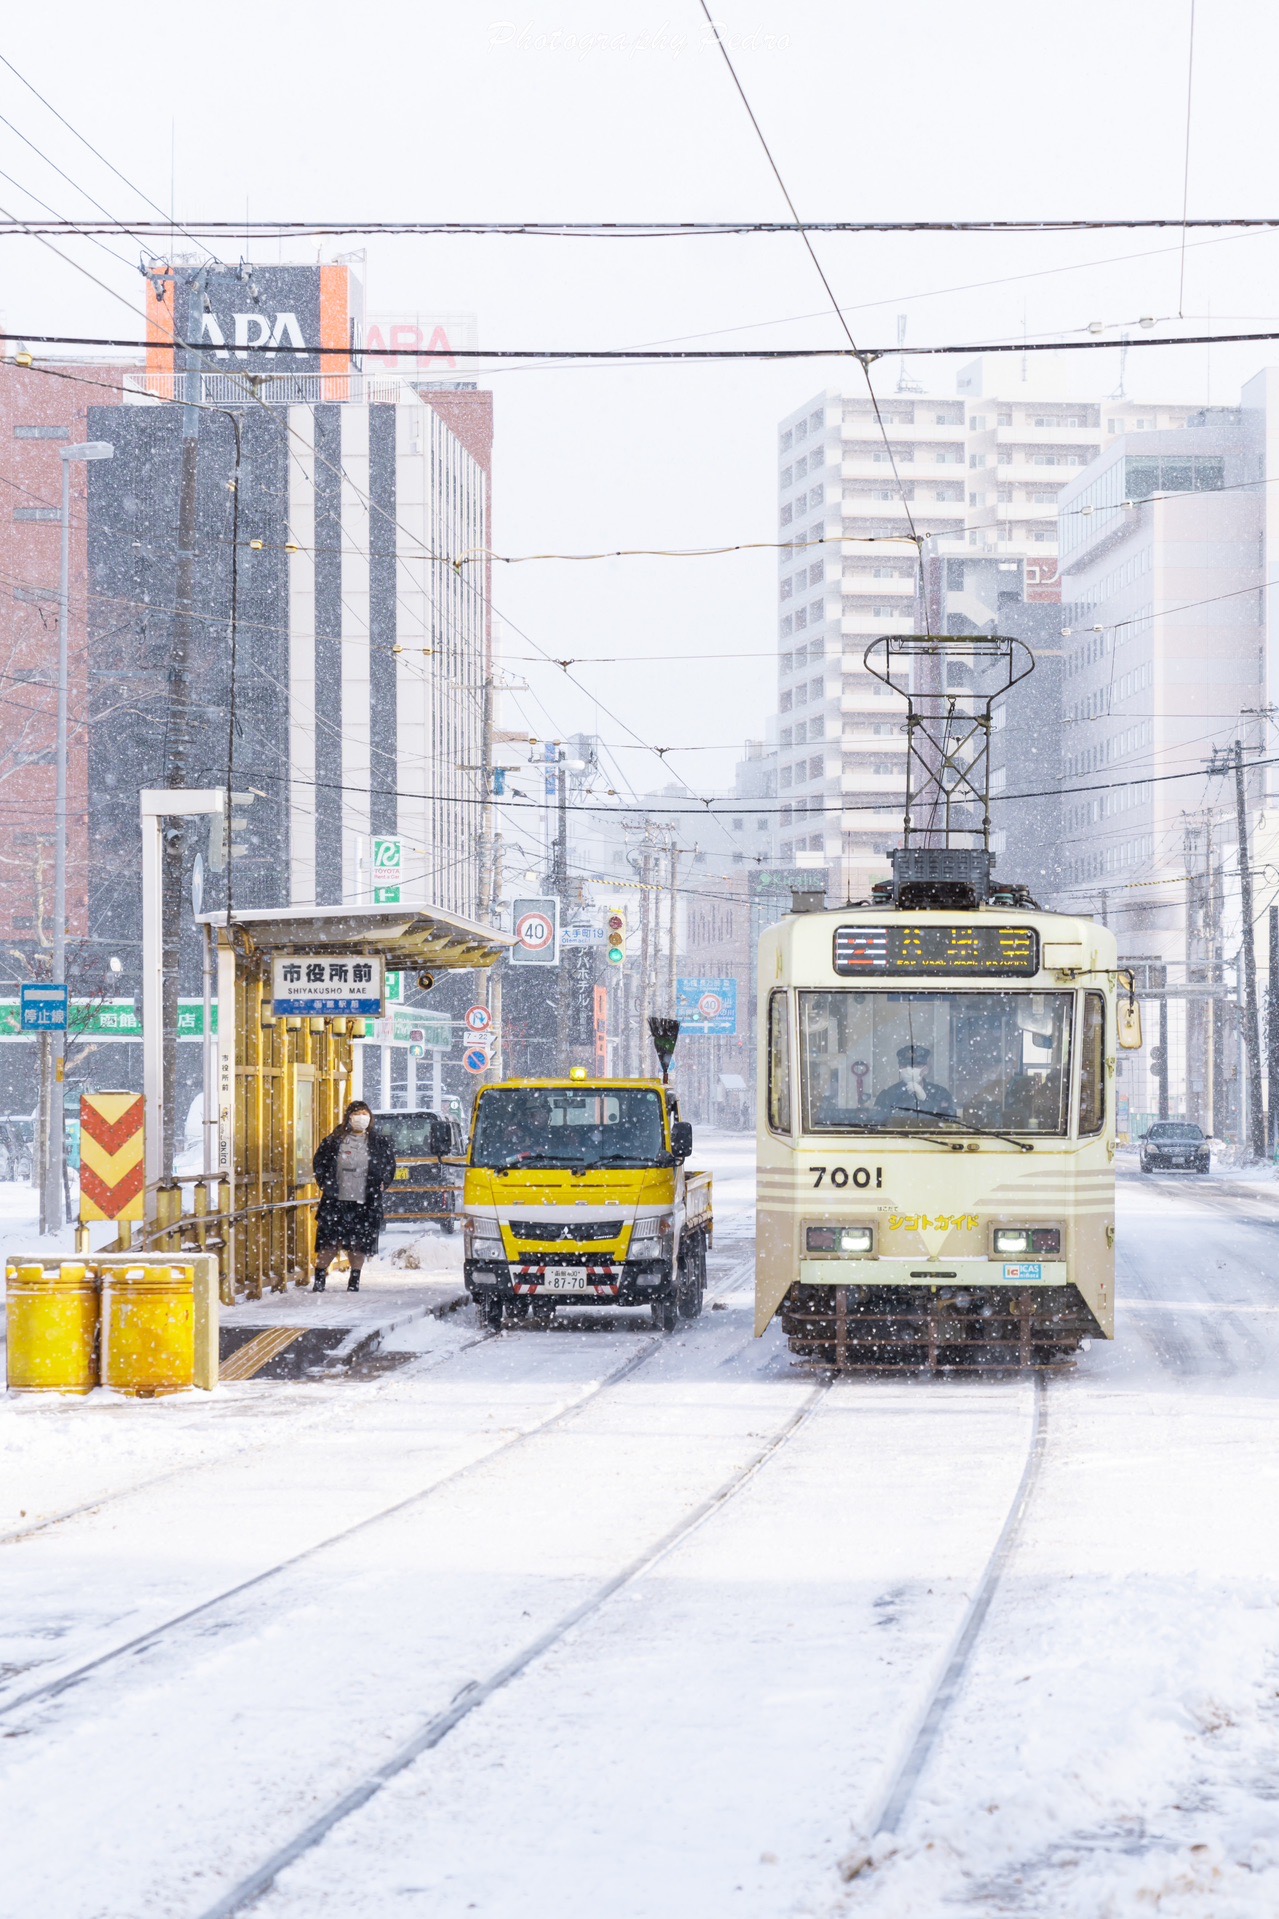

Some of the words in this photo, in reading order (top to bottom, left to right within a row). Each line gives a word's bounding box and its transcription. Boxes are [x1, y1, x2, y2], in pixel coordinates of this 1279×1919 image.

[202, 313, 309, 358] APA
[525, 924, 544, 940] 40
[282, 963, 372, 984] 市役所前
[576, 945, 590, 1007] アパホテル
[288, 987, 343, 995] SHIYAKUSHO
[349, 987, 367, 995] MAE
[704, 1000, 717, 1010] 40
[24, 1008, 65, 1025] 停止線
[809, 1167, 883, 1188] 7001
[888, 1214, 980, 1231] シゴトガイド
[1020, 1265, 1039, 1273] ICAS
[554, 1278, 585, 1289] 87-70
